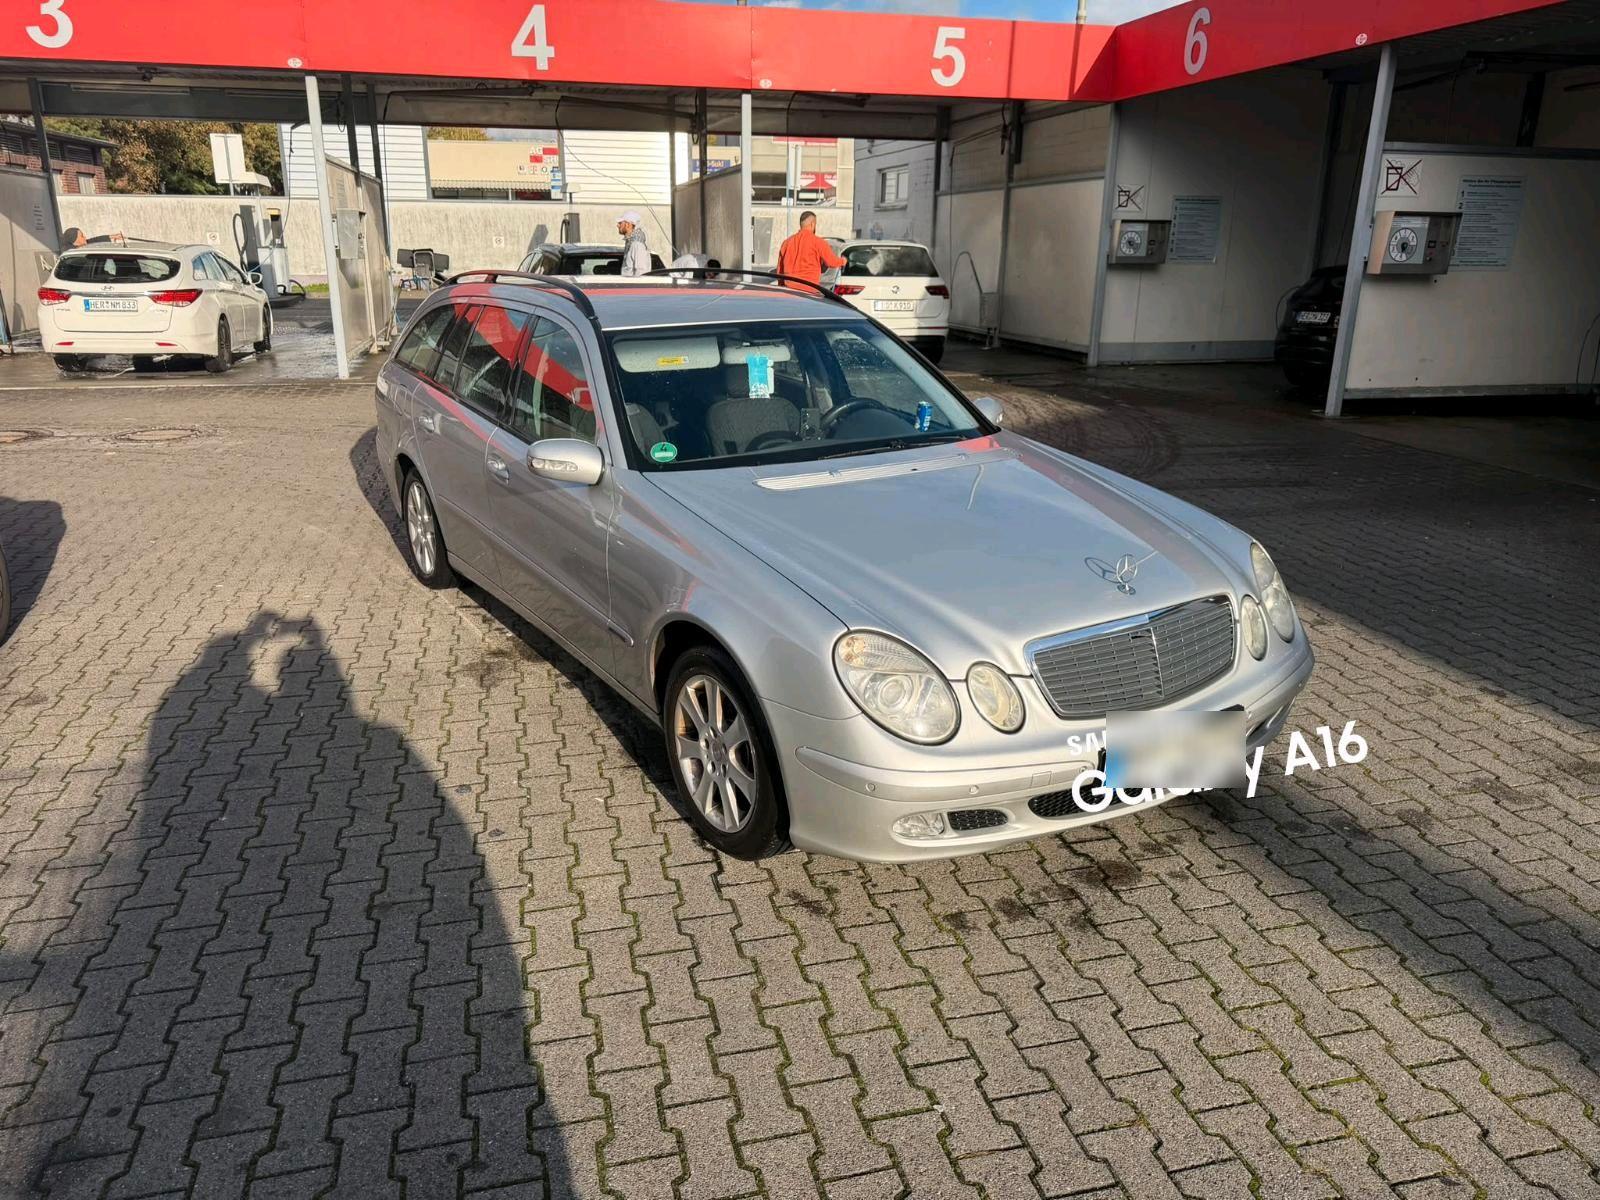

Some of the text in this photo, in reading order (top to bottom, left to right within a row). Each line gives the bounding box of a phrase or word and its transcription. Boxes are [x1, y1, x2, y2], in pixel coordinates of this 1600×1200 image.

[25, 0, 74, 48] 3
[511, 4, 555, 71] 4
[1184, 7, 1211, 76] 6
[931, 26, 966, 87] 5
[90, 301, 104, 309] HER
[122, 301, 136, 309] 833
[660, 443, 667, 452] 4
